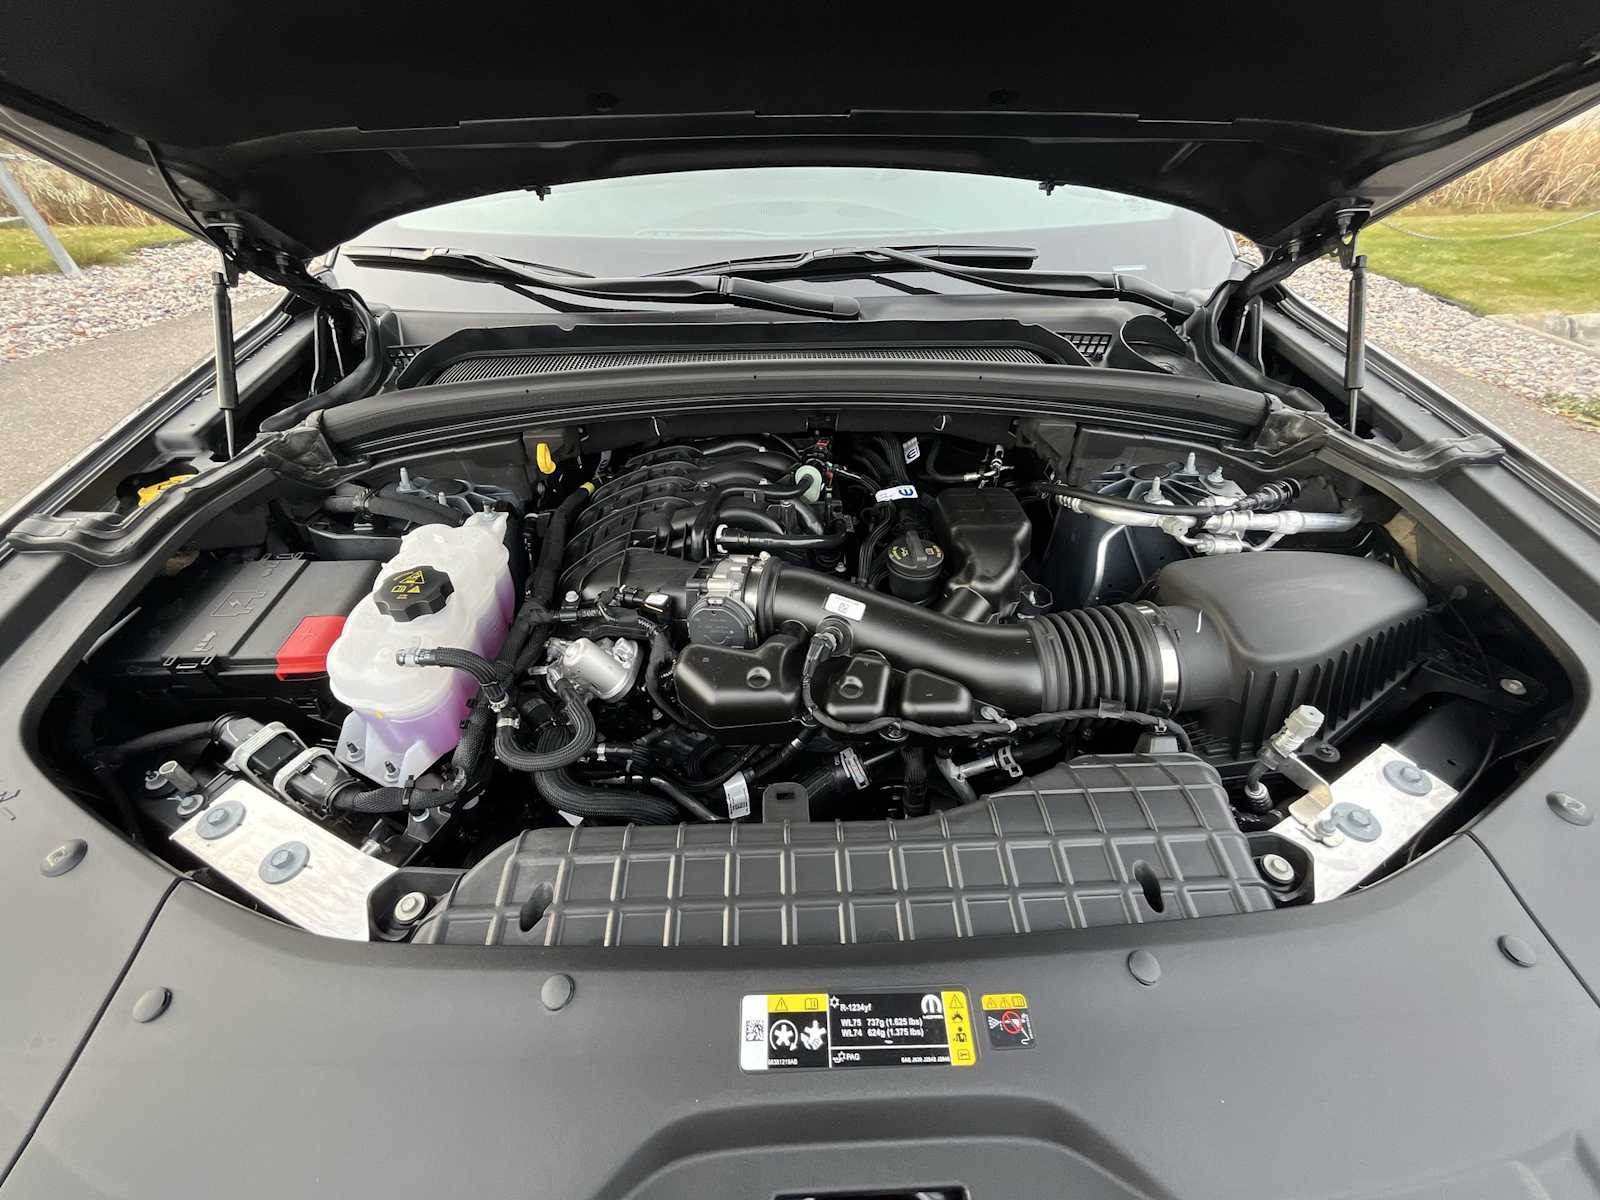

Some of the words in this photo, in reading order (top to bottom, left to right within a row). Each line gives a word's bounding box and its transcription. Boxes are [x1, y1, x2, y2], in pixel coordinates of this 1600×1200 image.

[840, 1003, 872, 1013] R-1234yf
[840, 1018, 862, 1027] WL75
[867, 1018, 885, 1028] 737g
[885, 1017, 908, 1027] (1.625
[908, 1017, 923, 1027] lbs)
[841, 1028, 863, 1037] WL74
[867, 1028, 886, 1038] 624g
[886, 1028, 909, 1038] (1.375
[909, 1027, 924, 1037] lbs)
[846, 1053, 860, 1061] PAG
